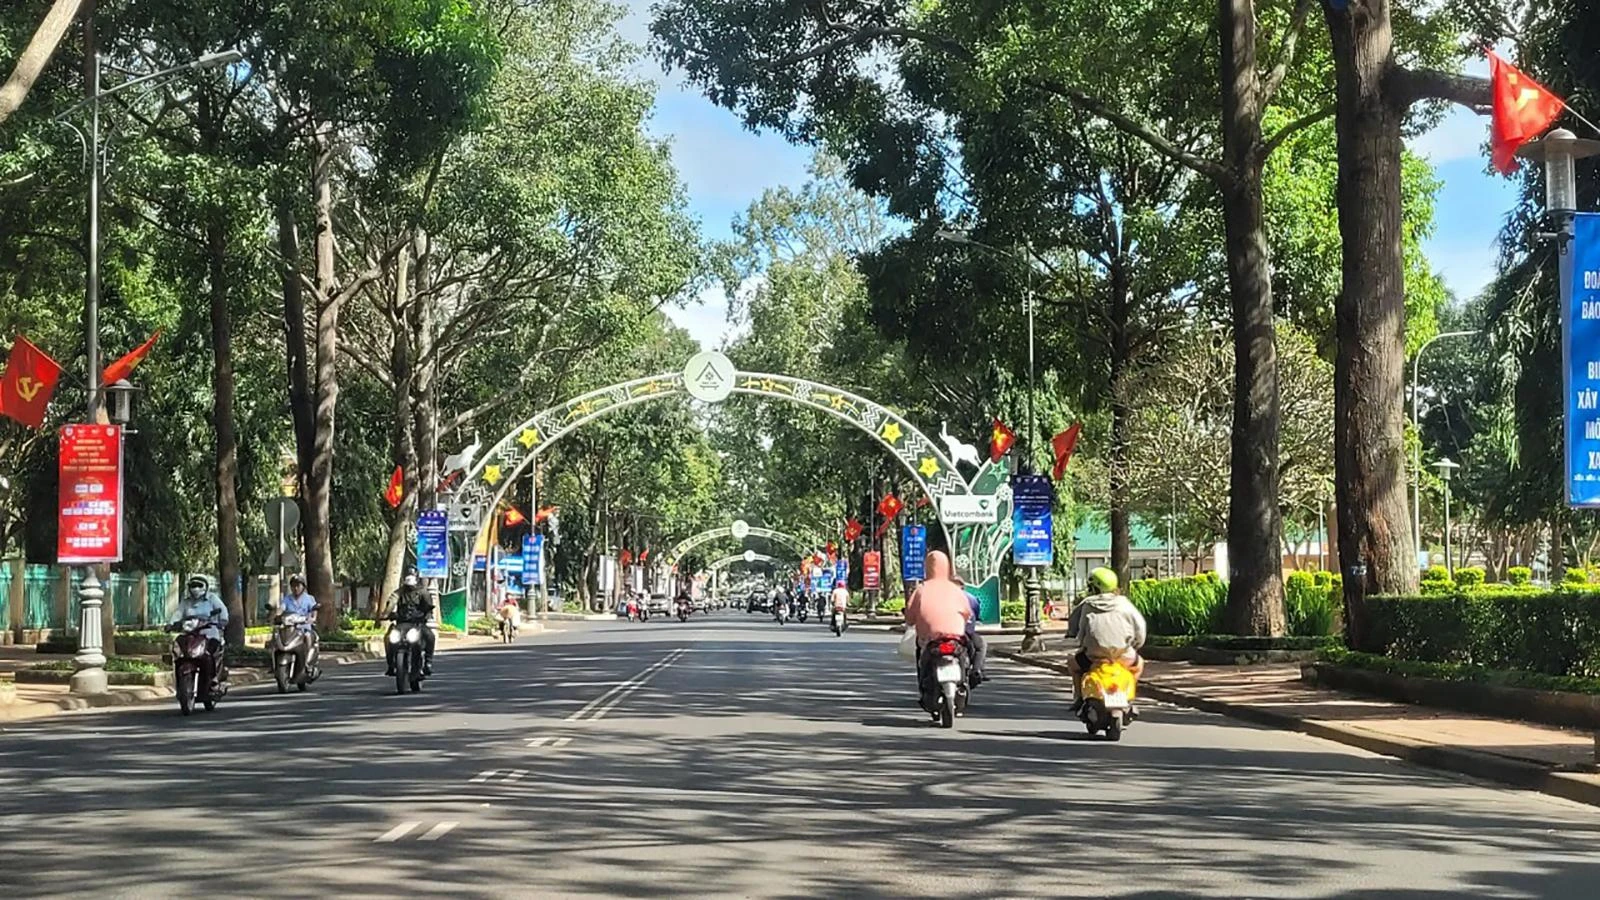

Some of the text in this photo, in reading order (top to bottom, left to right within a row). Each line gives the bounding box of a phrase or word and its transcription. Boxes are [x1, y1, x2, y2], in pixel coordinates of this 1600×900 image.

[1588, 361, 1600, 379] BI
[1577, 387, 1598, 409] XÂY
[944, 510, 993, 518] Vietcombank
